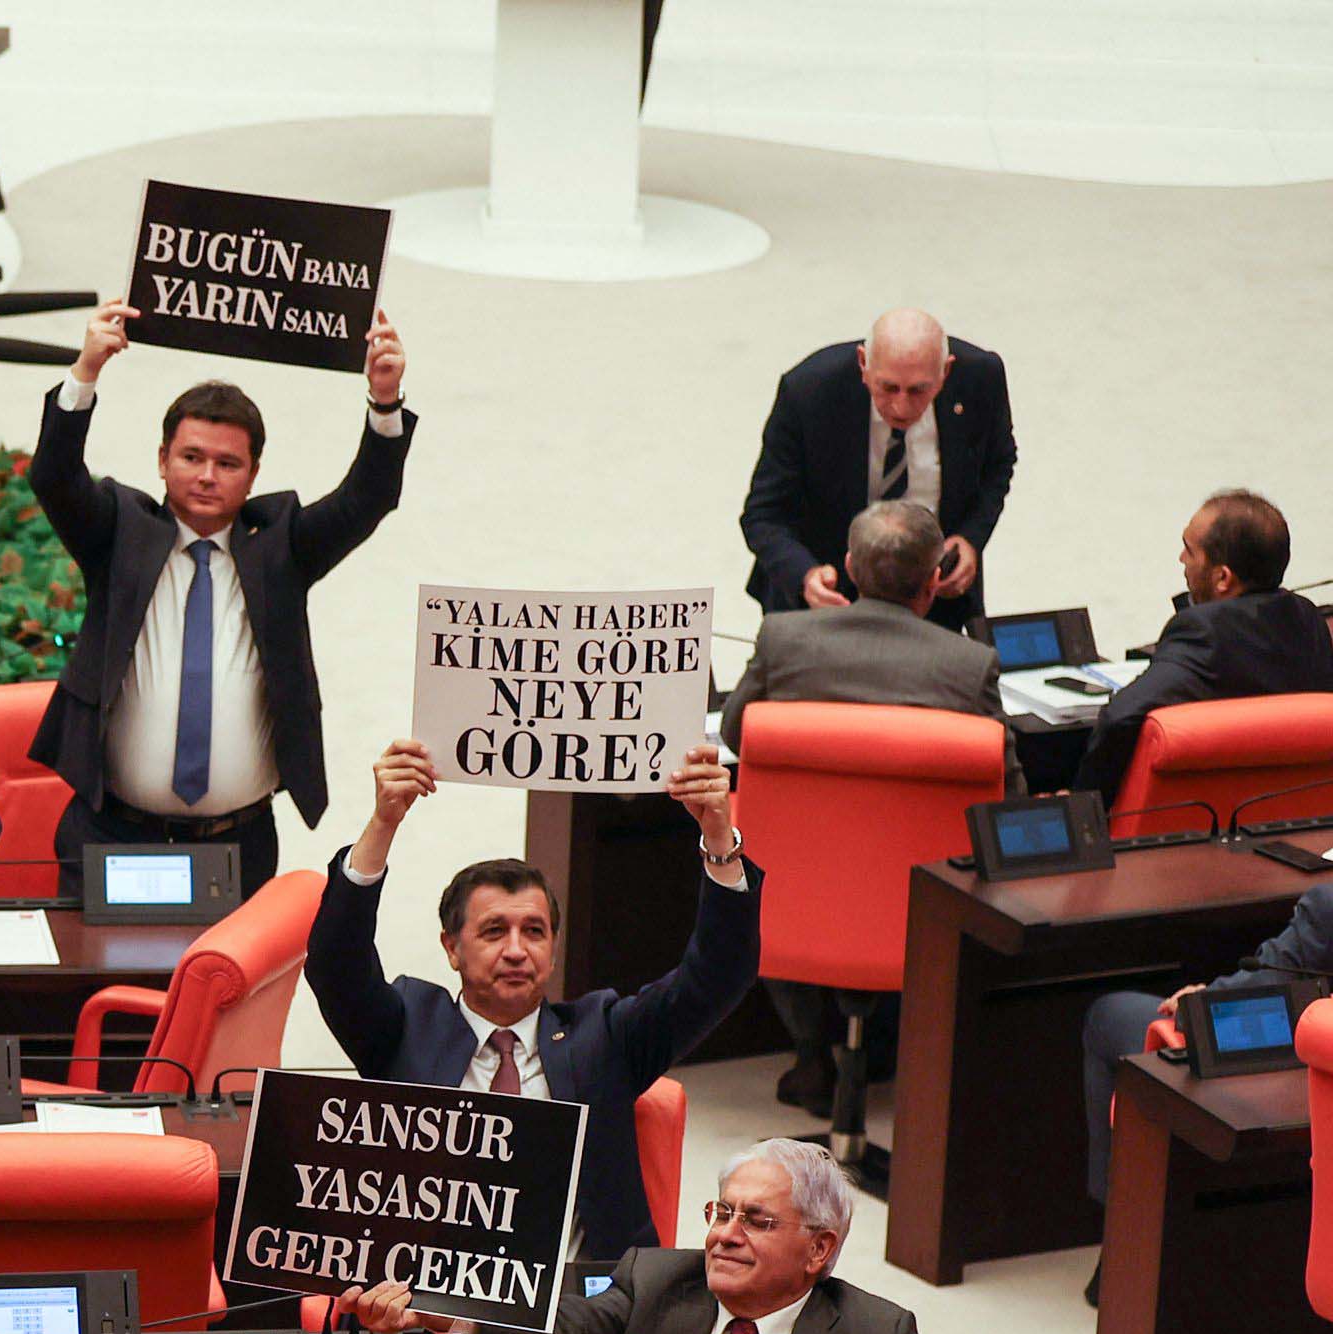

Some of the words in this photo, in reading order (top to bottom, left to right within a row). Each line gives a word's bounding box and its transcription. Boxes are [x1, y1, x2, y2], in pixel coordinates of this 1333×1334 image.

[144, 223, 302, 282] BUGÜN
[302, 258, 371, 290] BANA
[152, 274, 283, 330] YARIN
[283, 307, 348, 339] SANA
[431, 627, 559, 672] KİME
[577, 631, 700, 675] GÖRE
[487, 679, 643, 721] NEYE
[455, 718, 668, 782] GÖRE?
[316, 1098, 514, 1162] SANSÜR
[294, 1164, 519, 1233] YASASINI
[246, 1226, 374, 1283] GERİ
